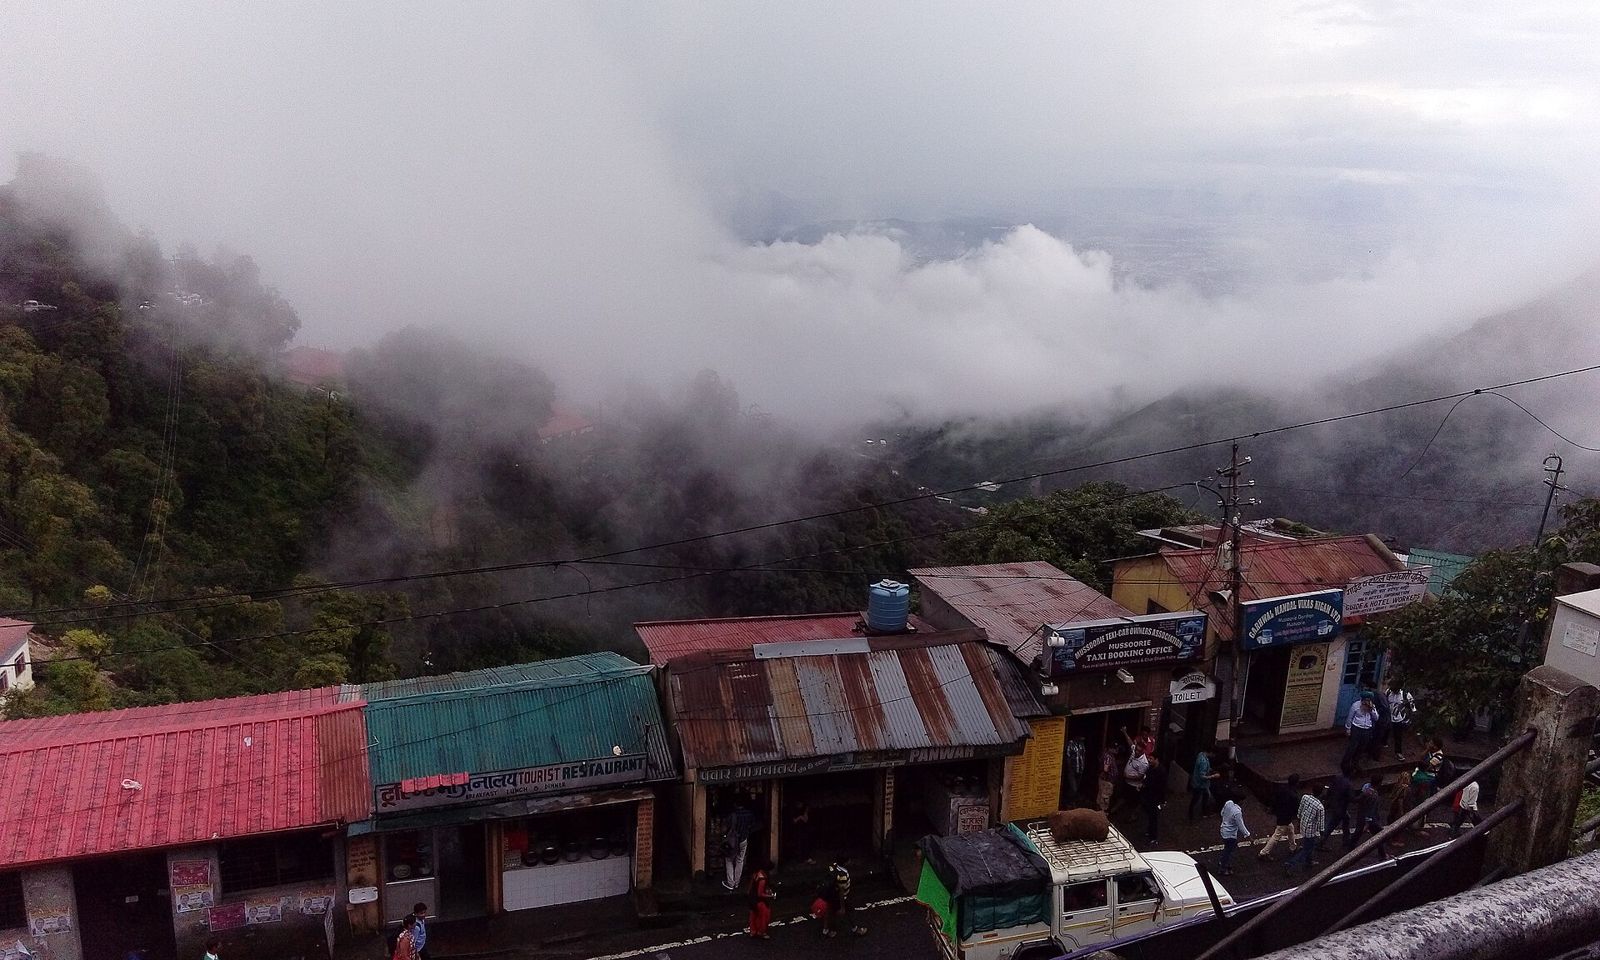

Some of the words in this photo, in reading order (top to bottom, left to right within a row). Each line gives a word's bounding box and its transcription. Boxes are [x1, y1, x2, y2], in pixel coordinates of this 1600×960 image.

[1345, 602, 1363, 611] GUIDE
[1370, 598, 1390, 608] HOTEL
[1074, 635, 1105, 659] MUSSOORIE
[1151, 628, 1184, 649] ASSOCIATION
[1108, 639, 1151, 650] MUSSOORIE
[1086, 652, 1106, 662] TAXI
[1107, 649, 1144, 660] BOOKING
[1145, 645, 1173, 655] OFFICE
[1174, 691, 1201, 702] TOILET
[909, 746, 974, 763] PANWAR
[519, 768, 561, 785] TOURIST
[562, 757, 644, 780] RESTAURANT
[466, 791, 498, 801] BREAKFAST
[506, 786, 528, 795] LUNCH
[544, 781, 566, 790] DINNER
